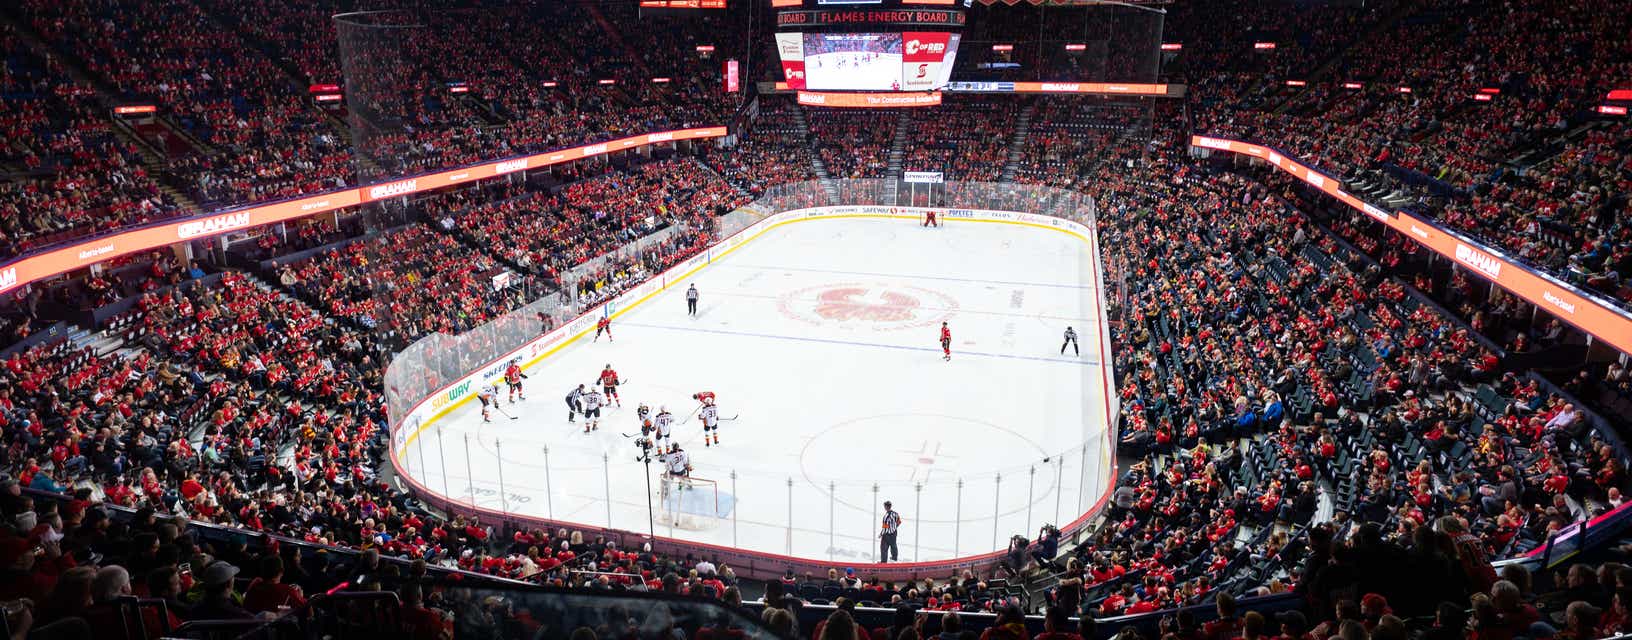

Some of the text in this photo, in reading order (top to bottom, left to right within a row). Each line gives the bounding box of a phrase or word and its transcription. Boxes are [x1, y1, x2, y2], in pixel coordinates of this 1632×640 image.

[821, 12, 865, 23] FLAMES
[868, 11, 913, 22] ENERGY
[916, 12, 947, 22] BOARD
[928, 43, 945, 51] RED
[371, 180, 416, 199] GRAHAM
[178, 212, 250, 239] GRAHAM
[1456, 244, 1501, 279] GRAHAM
[538, 332, 566, 351] Scotiabank
[483, 354, 523, 380] SKECHRS
[432, 380, 472, 412] SUBWAY
